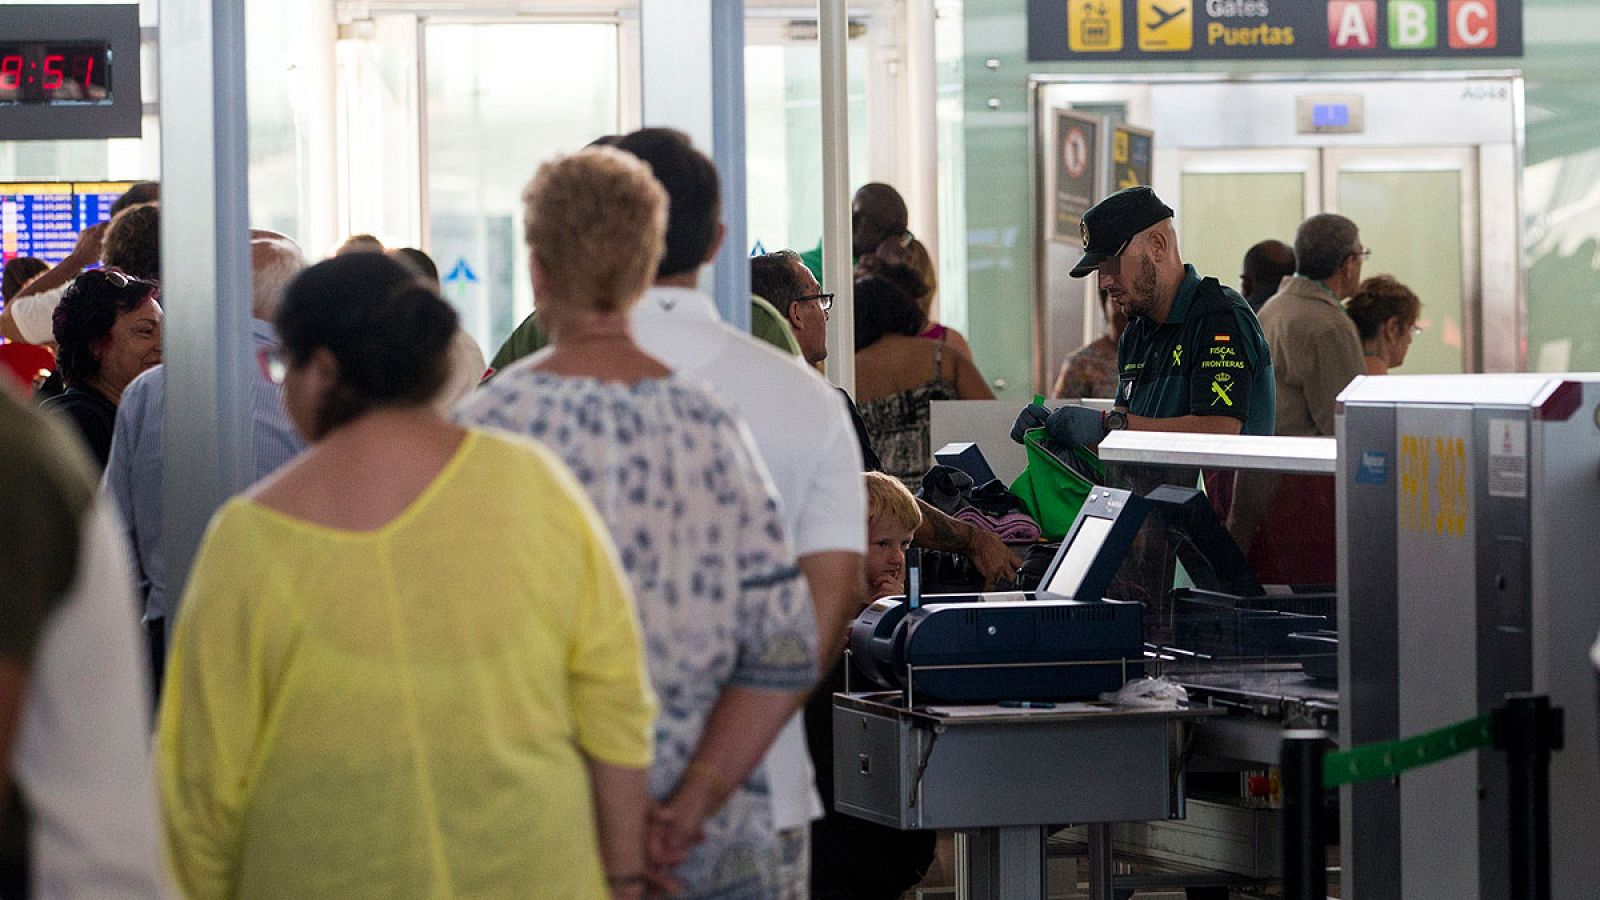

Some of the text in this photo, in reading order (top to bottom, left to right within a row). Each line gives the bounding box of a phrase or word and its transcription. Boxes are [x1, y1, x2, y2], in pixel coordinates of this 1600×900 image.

[1206, 0, 1269, 17] Gates
[1336, 1, 1489, 46] A B C
[1207, 22, 1295, 47] Puertas
[1210, 346, 1236, 355] FISCAL
[1201, 360, 1245, 369] FRONTERAS
